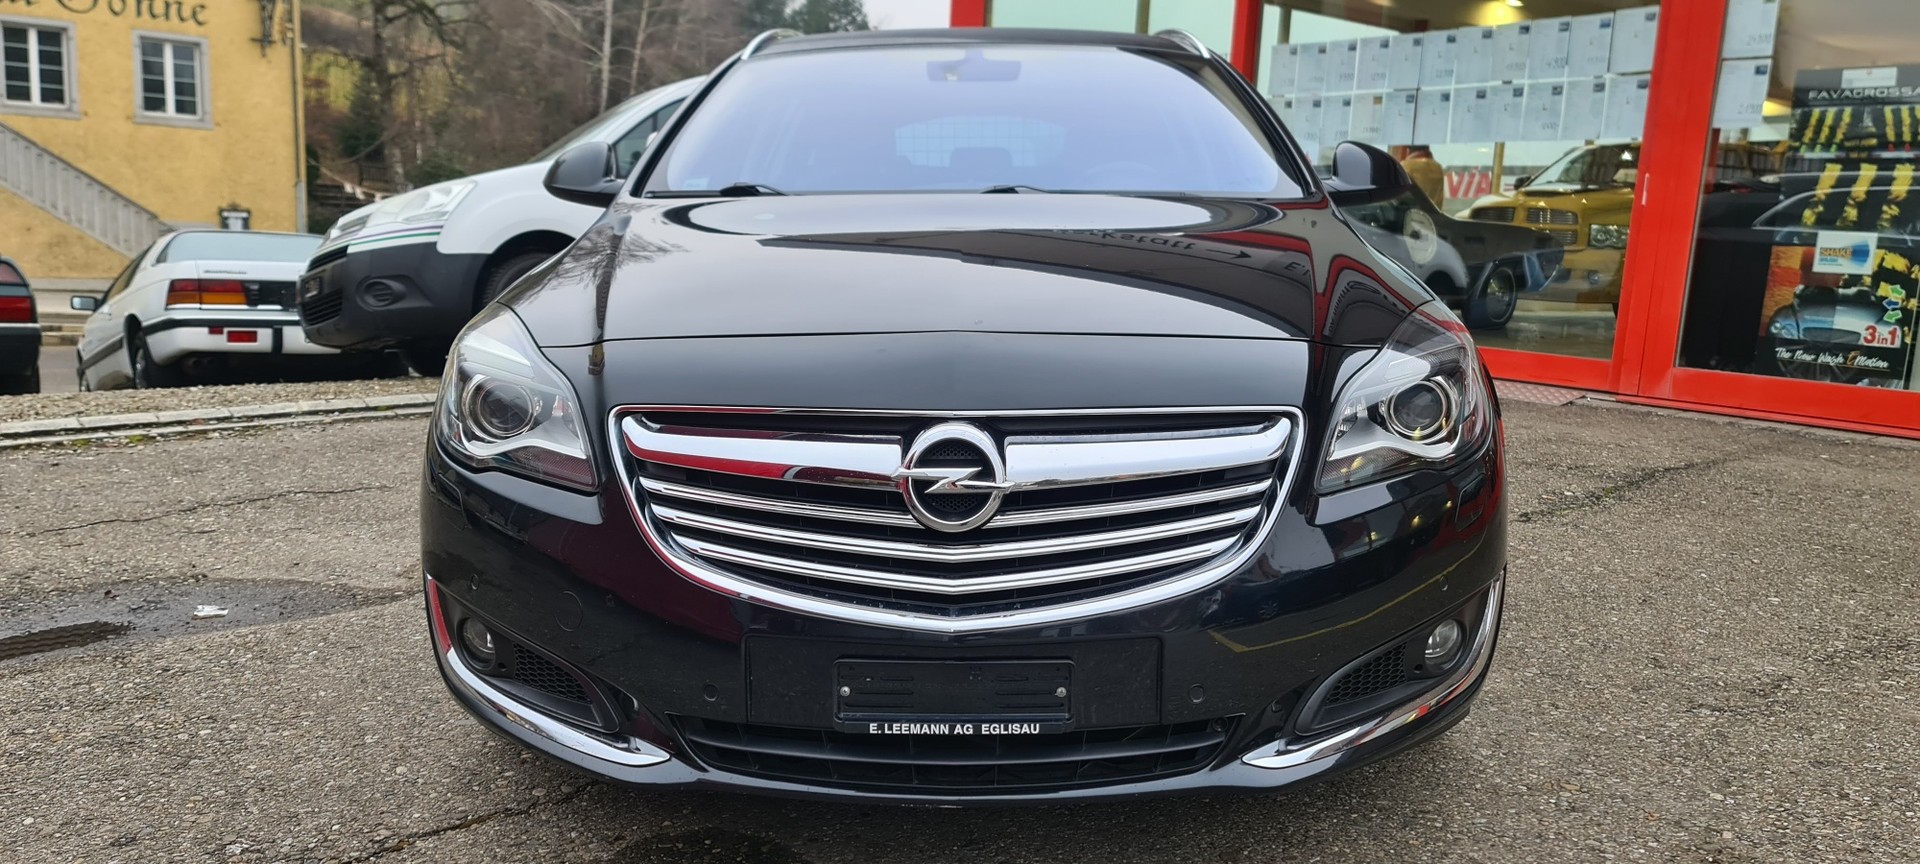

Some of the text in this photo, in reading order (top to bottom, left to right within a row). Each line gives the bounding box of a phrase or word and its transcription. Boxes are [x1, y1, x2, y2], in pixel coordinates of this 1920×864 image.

[1808, 87, 1920, 100] FAVAGROSSA
[1819, 247, 1852, 258] SHAKE
[1775, 347, 1794, 359] The
[1818, 352, 1845, 366] Wash
[869, 723, 1040, 735] E. LEEMANN AG EGLISAU
